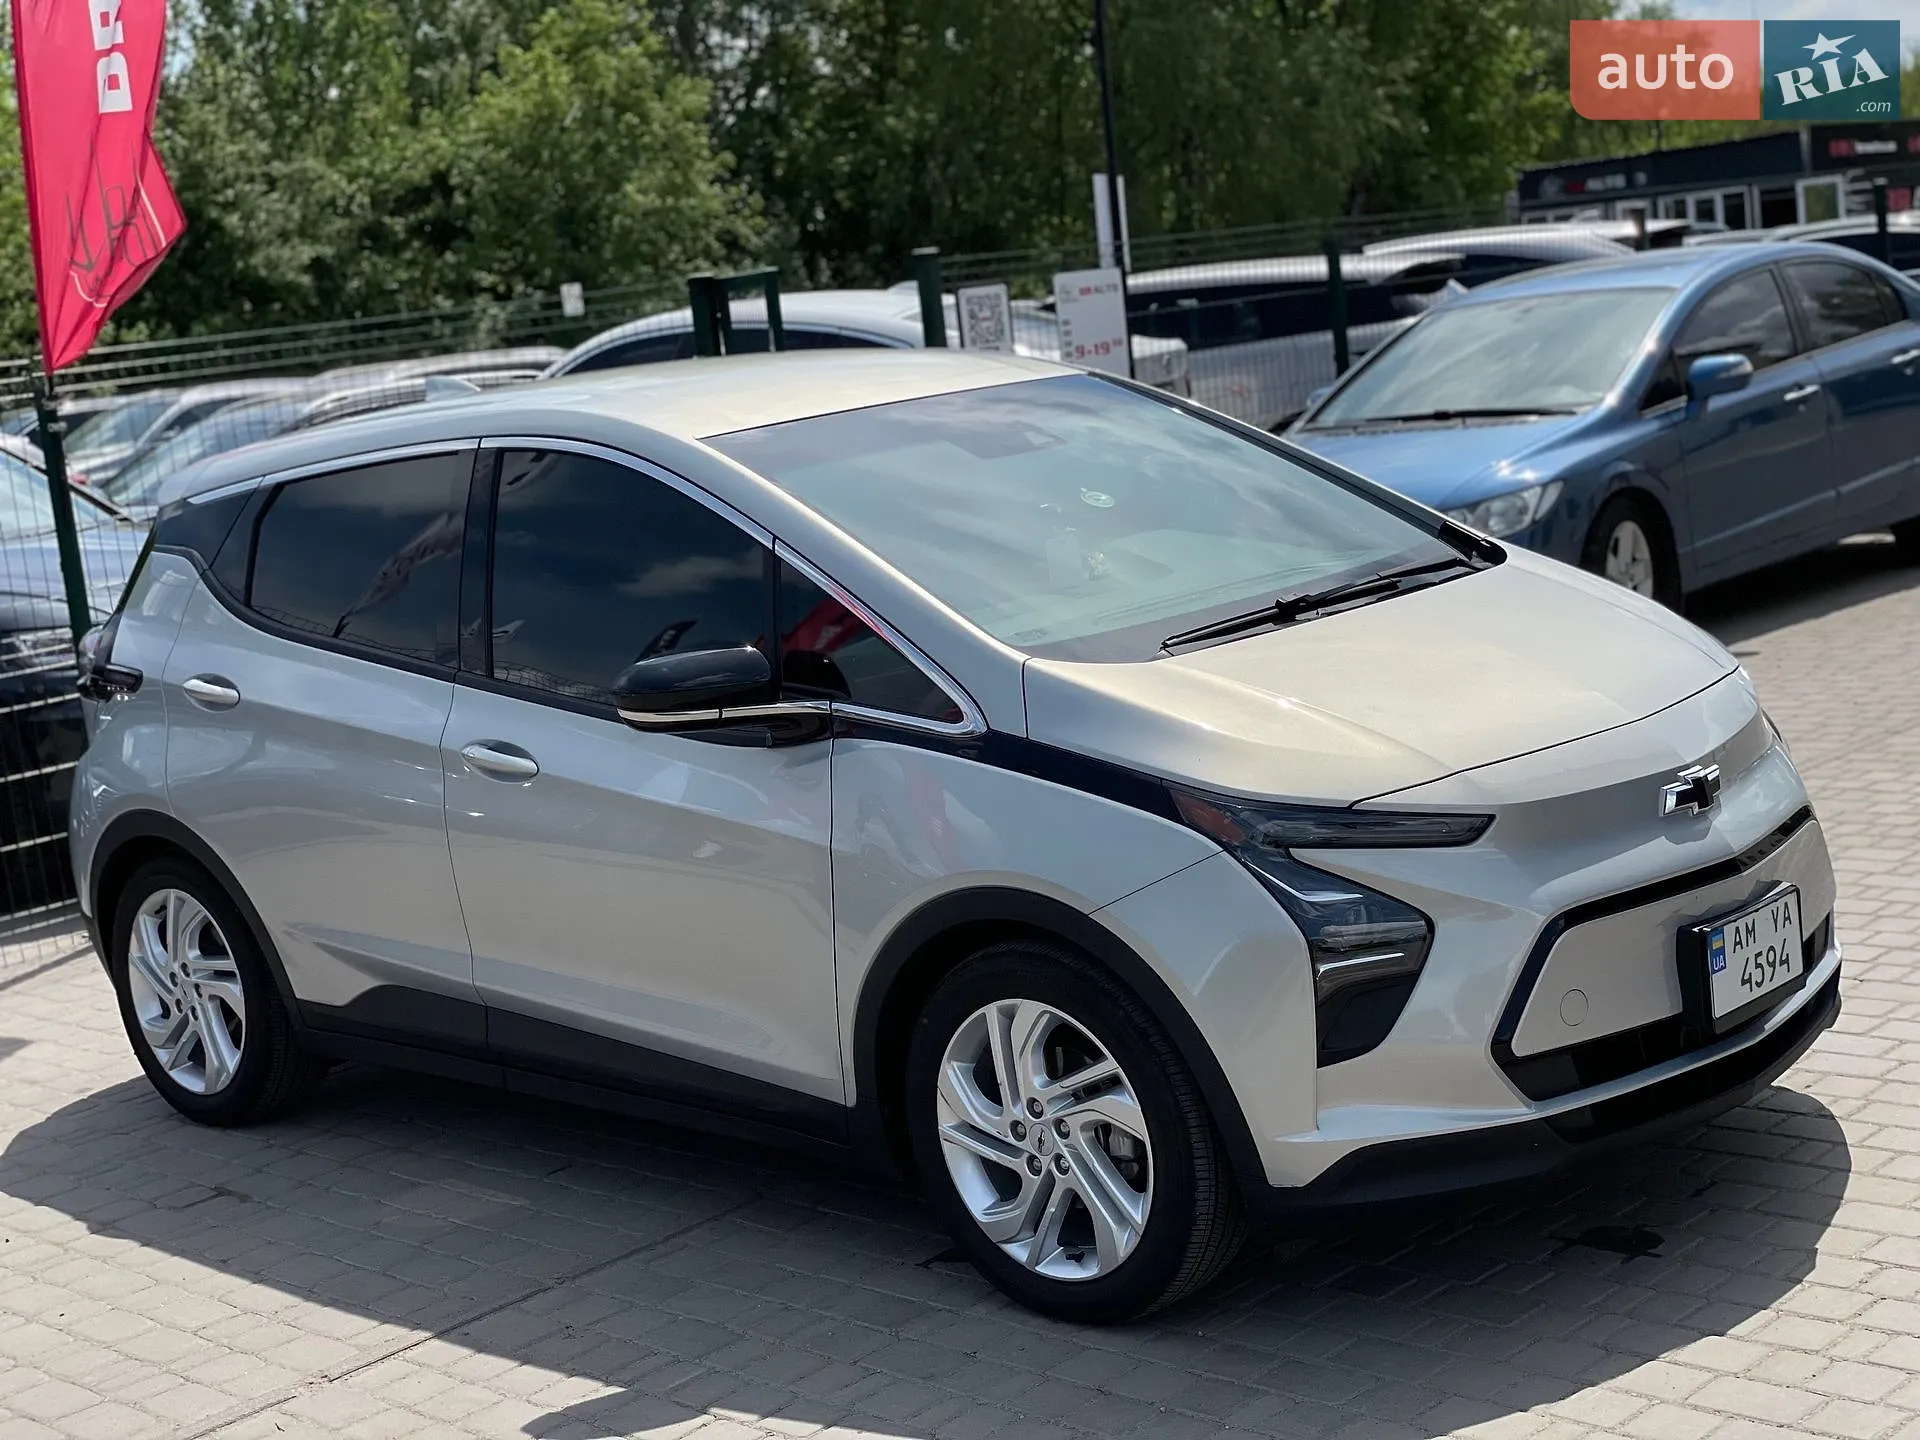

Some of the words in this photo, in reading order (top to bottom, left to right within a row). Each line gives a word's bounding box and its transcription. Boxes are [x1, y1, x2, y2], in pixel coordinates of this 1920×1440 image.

[1733, 919, 1756, 954] AM
[1771, 901, 1792, 933] YA
[1713, 955, 1726, 971] UA
[1740, 938, 1790, 993] 4594
